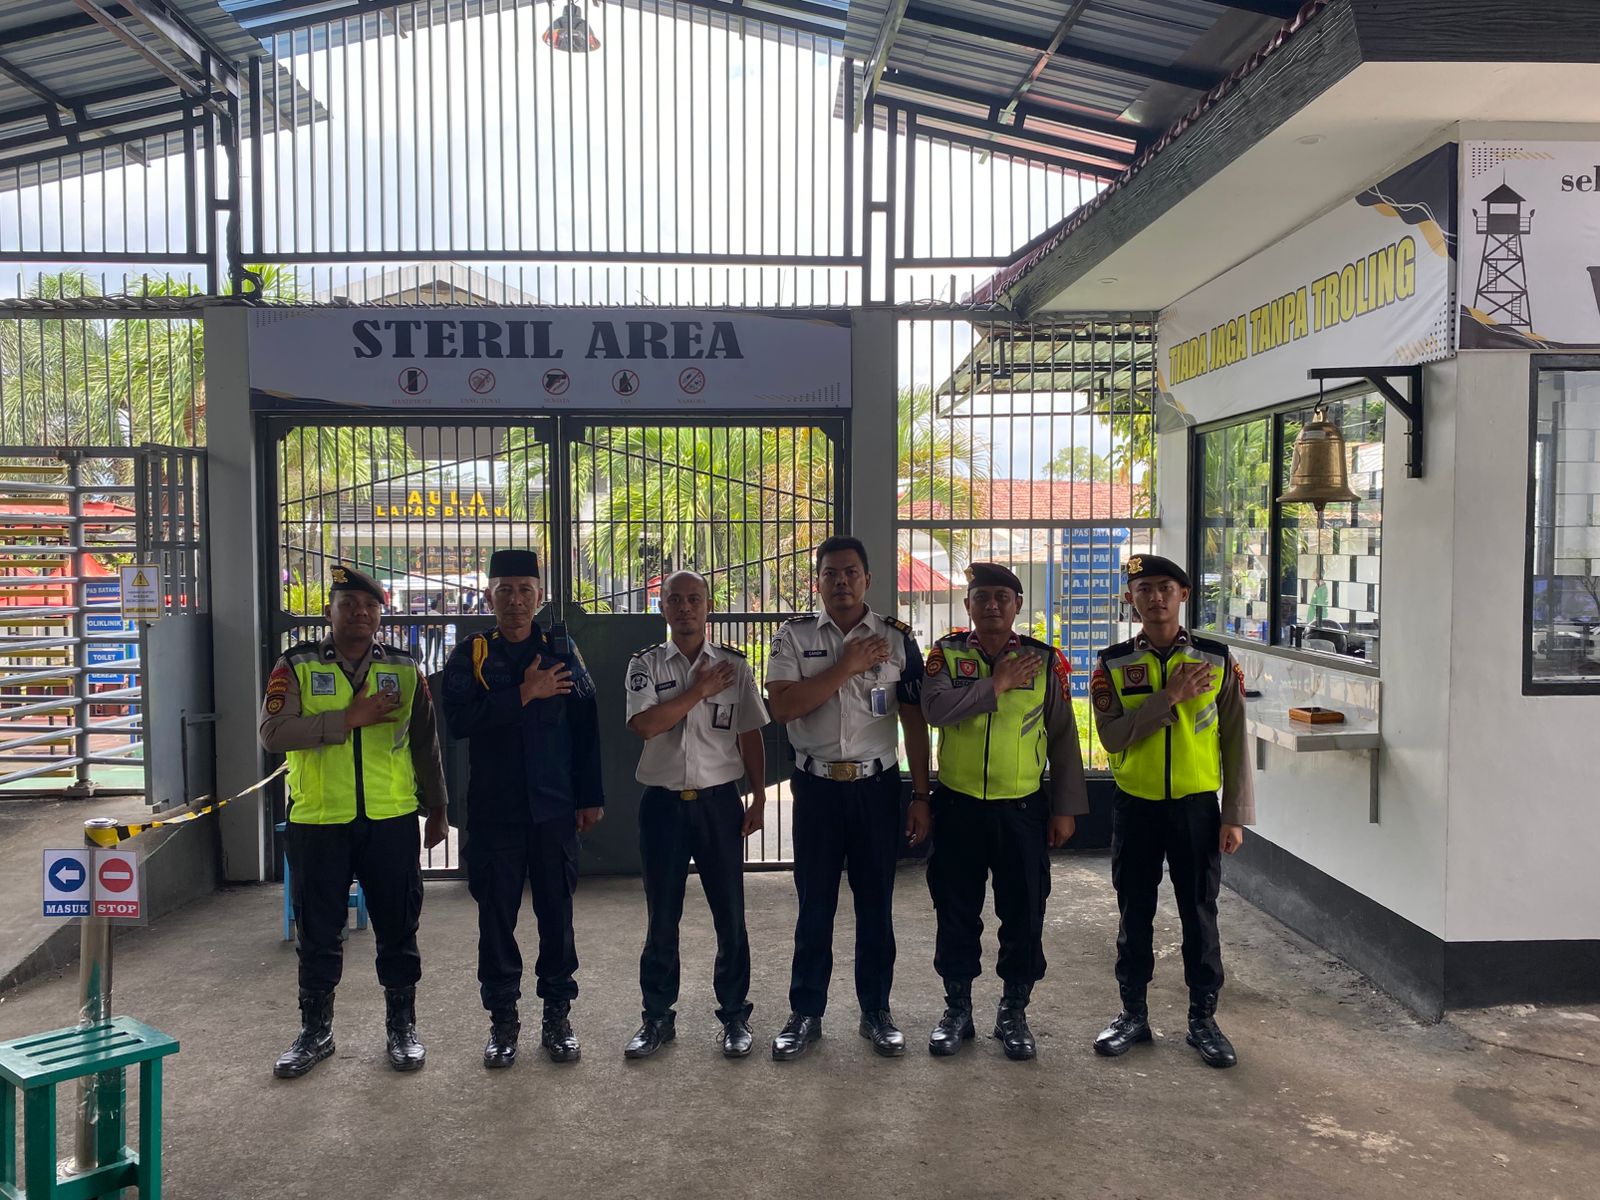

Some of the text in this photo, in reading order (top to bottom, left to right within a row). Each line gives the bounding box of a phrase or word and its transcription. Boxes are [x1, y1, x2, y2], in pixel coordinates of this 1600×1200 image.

[1169, 235, 1416, 386] TIADA JAGA TANPA TROLING
[352, 319, 744, 360] STERIL AREA
[408, 490, 485, 505] AULA
[376, 505, 436, 517] LAPAS
[46, 904, 88, 914] MASUK
[97, 904, 137, 914] STOP
